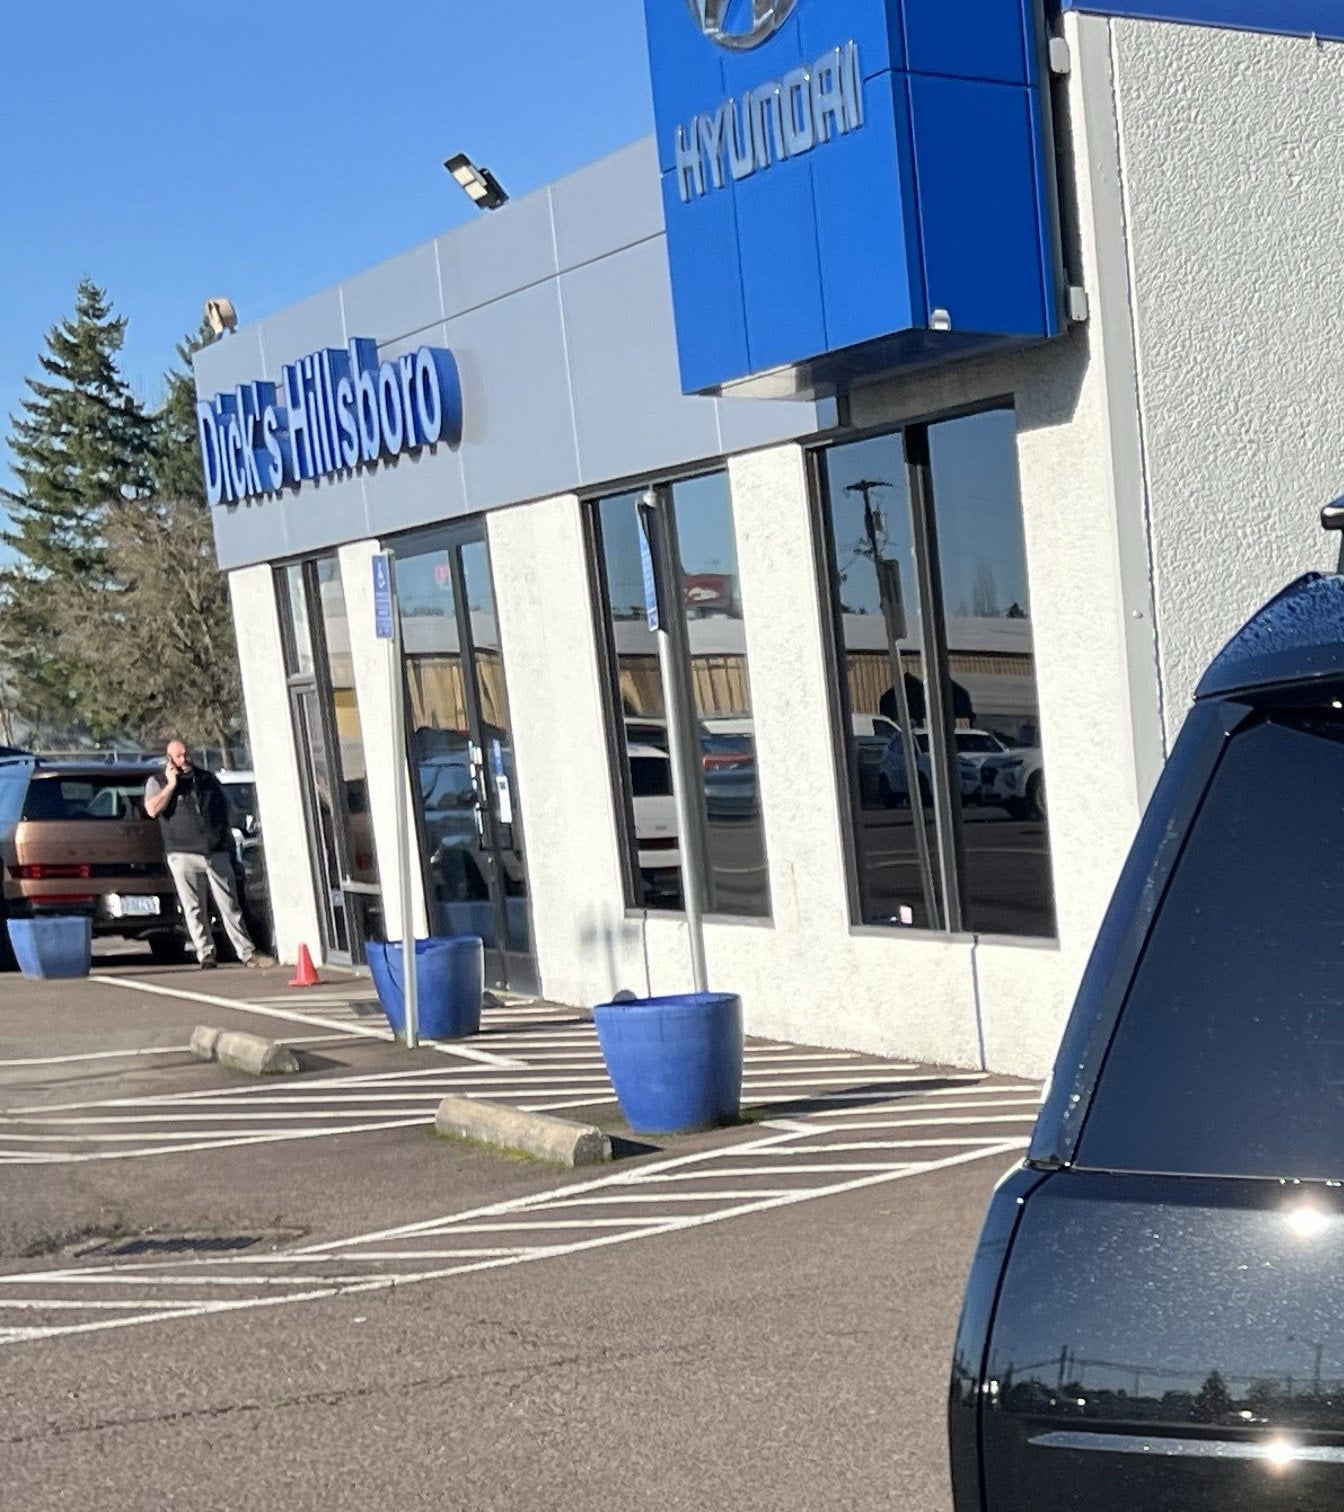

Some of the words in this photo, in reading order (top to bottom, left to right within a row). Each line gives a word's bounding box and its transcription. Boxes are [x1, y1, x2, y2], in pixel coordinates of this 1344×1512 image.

[675, 39, 864, 203] HYUNDAI
[197, 381, 284, 506] Dick's
[282, 337, 446, 483] Hillsboro
